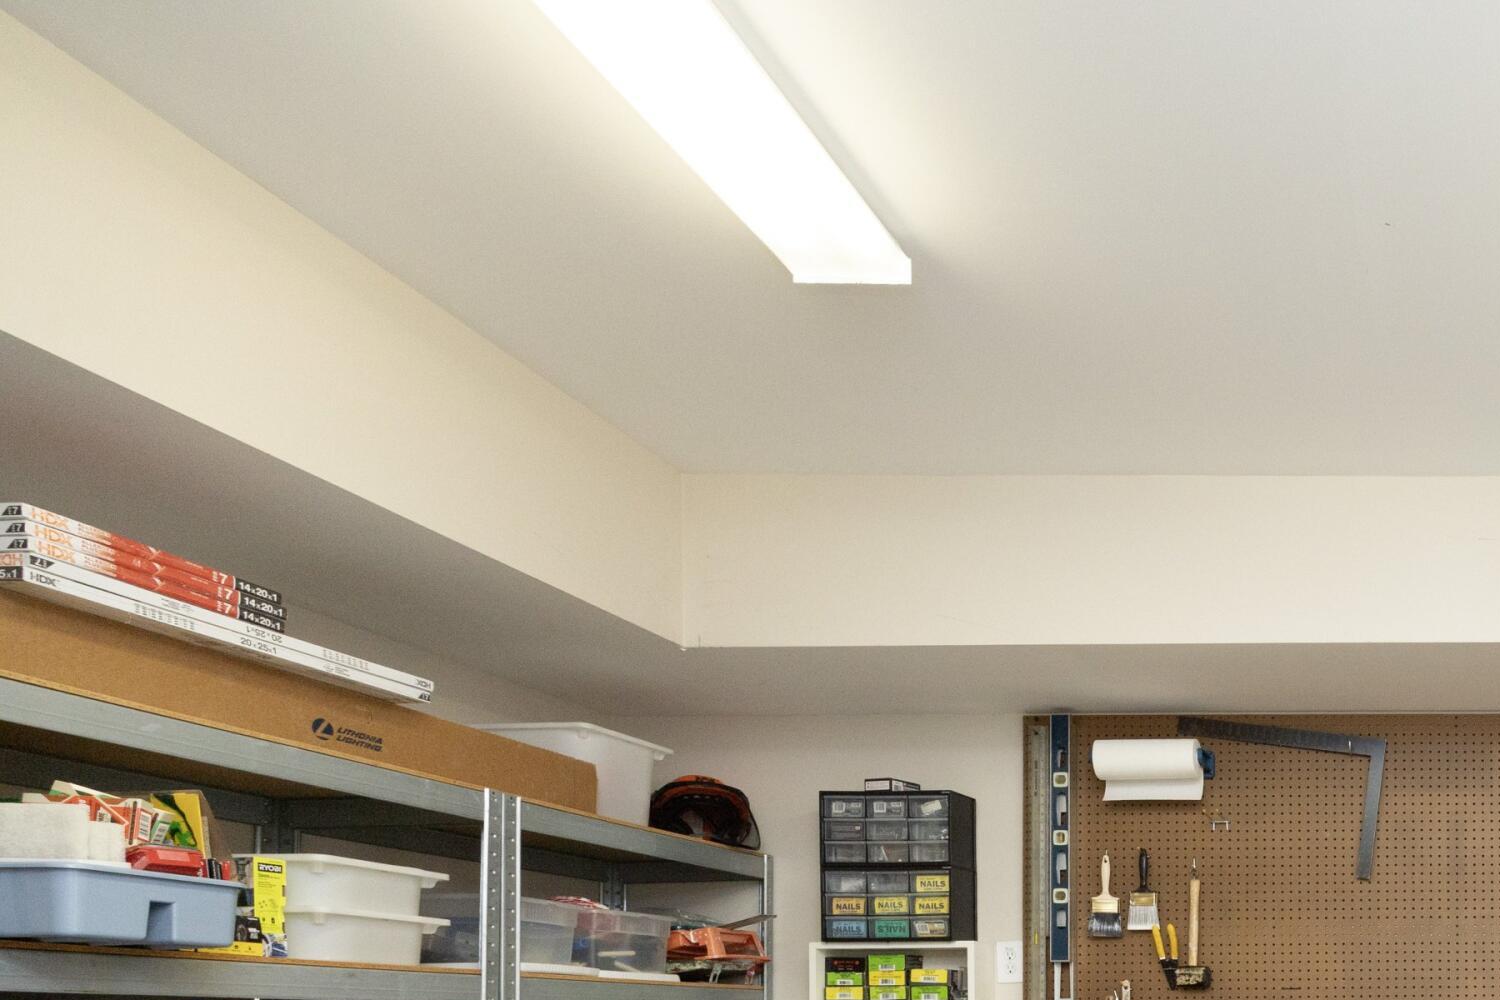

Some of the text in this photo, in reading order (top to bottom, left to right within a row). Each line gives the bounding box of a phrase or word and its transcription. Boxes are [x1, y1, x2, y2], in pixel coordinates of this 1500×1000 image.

[34, 524, 72, 548] HDX
[38, 540, 76, 566] HDX
[30, 571, 57, 587] HDX
[336, 735, 382, 752] LIGHTING
[337, 727, 383, 745] LITHONIA
[259, 863, 282, 873] RYOBI
[878, 901, 903, 909] NAILS
